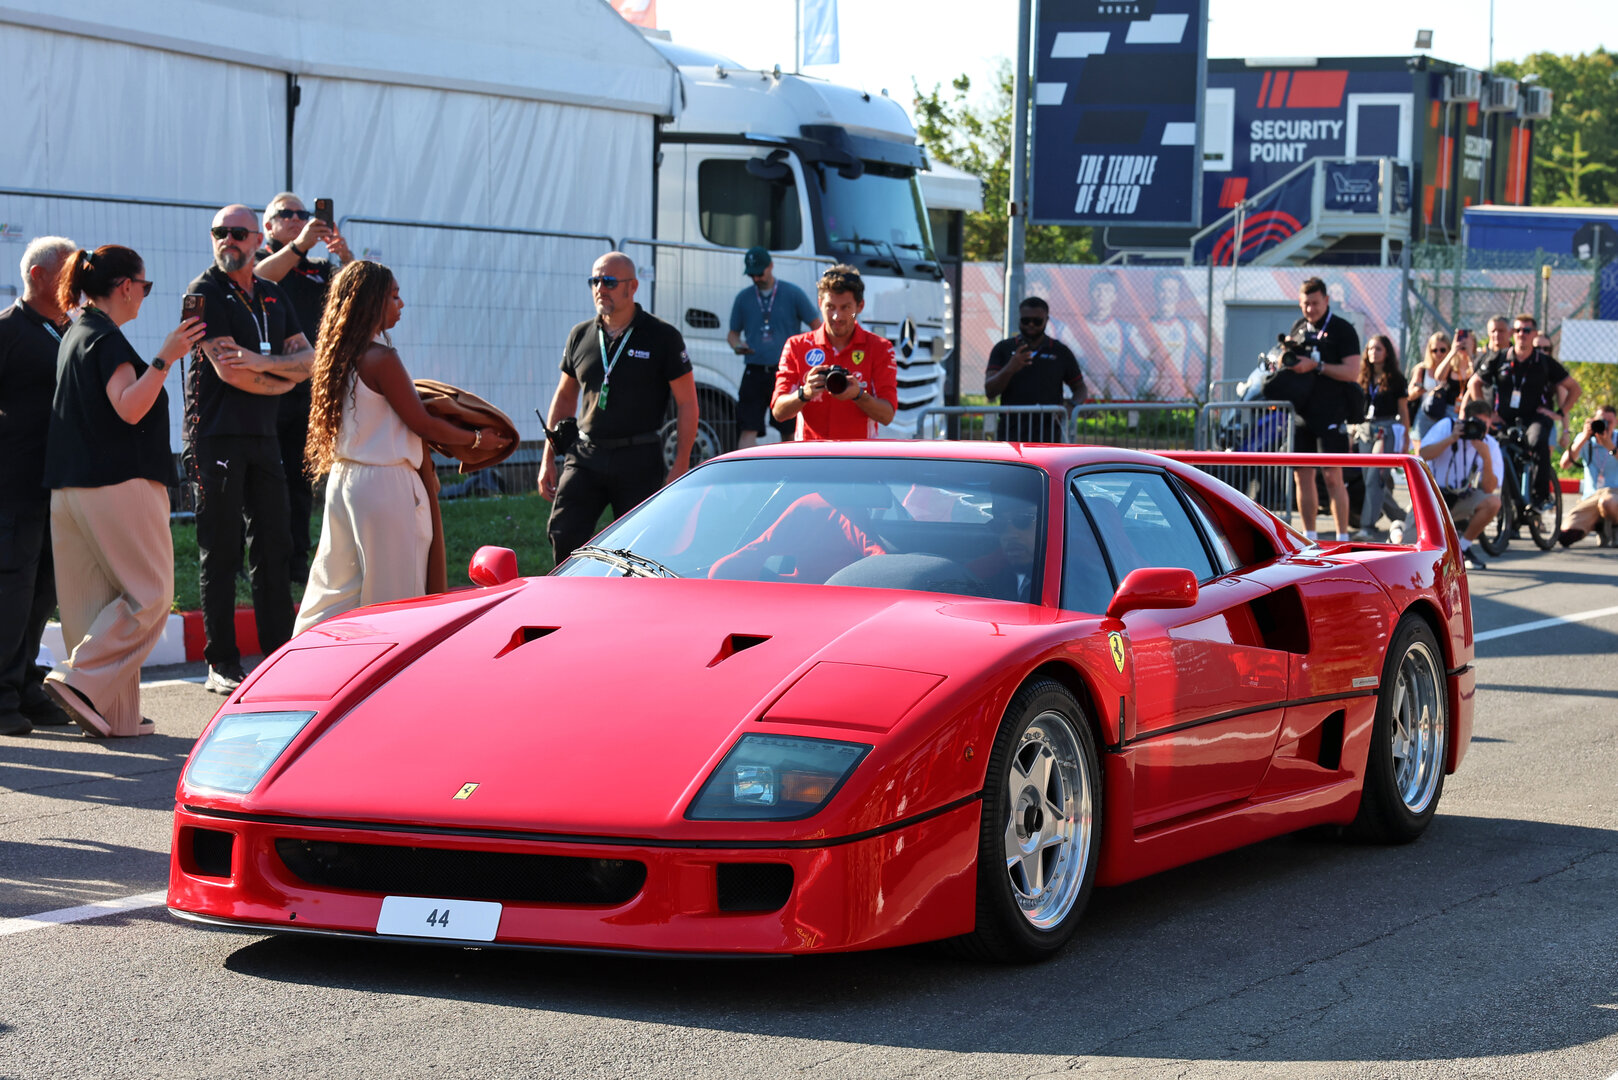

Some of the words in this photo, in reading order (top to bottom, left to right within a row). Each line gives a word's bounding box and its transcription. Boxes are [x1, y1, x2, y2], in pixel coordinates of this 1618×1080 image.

[1250, 119, 1344, 140] SECURITY
[1250, 142, 1307, 162] POINT
[1076, 154, 1105, 184] THE
[1104, 155, 1158, 185] TEMPLE
[1074, 184, 1096, 214] OF
[1095, 184, 1141, 214] SPEED
[807, 349, 823, 366] hp
[426, 908, 450, 928] 44
